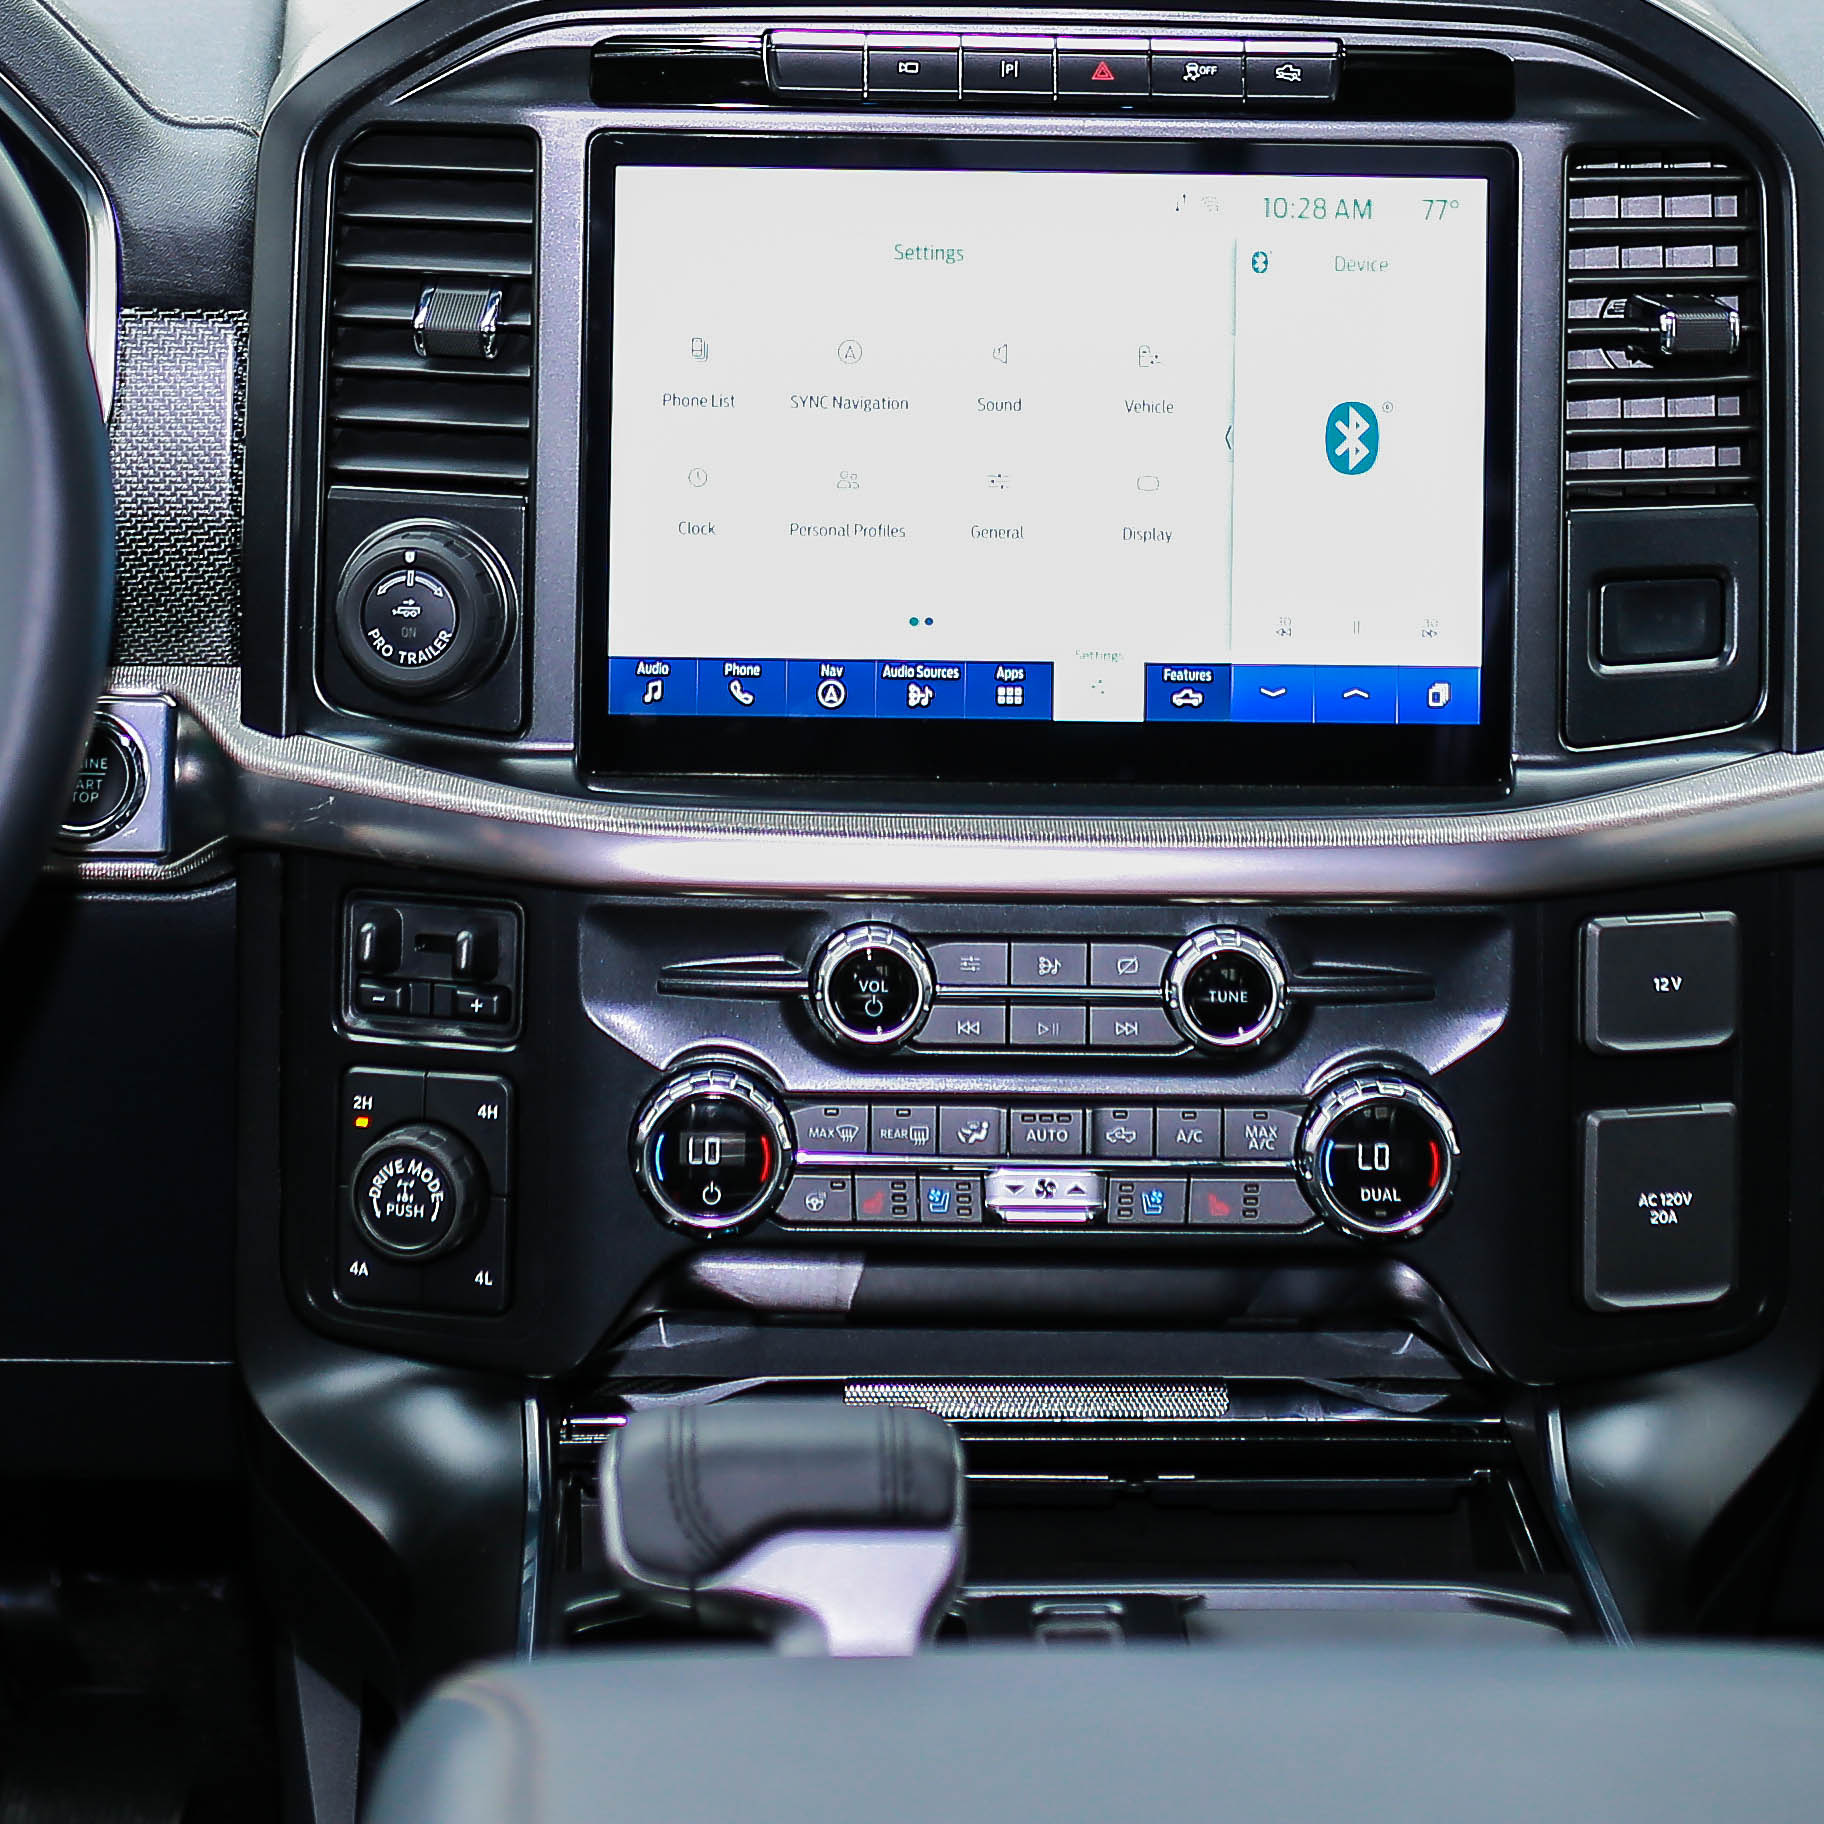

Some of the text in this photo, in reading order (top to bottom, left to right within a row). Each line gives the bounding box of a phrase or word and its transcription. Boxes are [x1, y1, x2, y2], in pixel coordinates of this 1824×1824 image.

[1198, 64, 1218, 77] OFF
[1263, 196, 1374, 221] 10:28 AM
[1421, 199, 1461, 222] 77°
[893, 243, 965, 265] Settings
[1333, 256, 1390, 273] Device
[662, 392, 736, 408] Phone List
[790, 394, 910, 414] SYNC Navigation
[976, 396, 1023, 413] Sound
[1124, 399, 1175, 415] Vehicle
[677, 521, 717, 536] Clock
[789, 522, 907, 539] Personal Profiles
[970, 524, 1025, 540] General
[1122, 526, 1173, 543] Display
[367, 628, 453, 665] PRO TRAILER
[636, 661, 670, 676] Audio
[724, 662, 761, 677] Phone
[820, 663, 844, 677] Nav
[882, 663, 960, 680] Audio Sources
[996, 666, 1025, 681] Apps
[1163, 667, 1213, 683] Features
[858, 980, 889, 993] VOL
[1653, 976, 1683, 993] 12V
[1208, 990, 1248, 1004] TUNE
[352, 1095, 373, 1111] 2H
[477, 1104, 499, 1120] 4H
[808, 1127, 835, 1139] MAX
[879, 1127, 909, 1141] REAR
[1026, 1129, 1069, 1143] AUTO
[1175, 1129, 1203, 1144] A/C
[1245, 1126, 1278, 1140] MAX
[688, 1136, 721, 1165] LO
[1248, 1138, 1275, 1152] A/C
[1357, 1142, 1390, 1172] LO
[368, 1158, 444, 1203] DRIVE MODE
[1360, 1187, 1402, 1203] DUAL
[1638, 1192, 1693, 1208] AC 120V
[386, 1202, 425, 1218] PUSH
[1649, 1210, 1678, 1225] 20A
[349, 1261, 369, 1277] 4A
[474, 1270, 493, 1286] 4L
